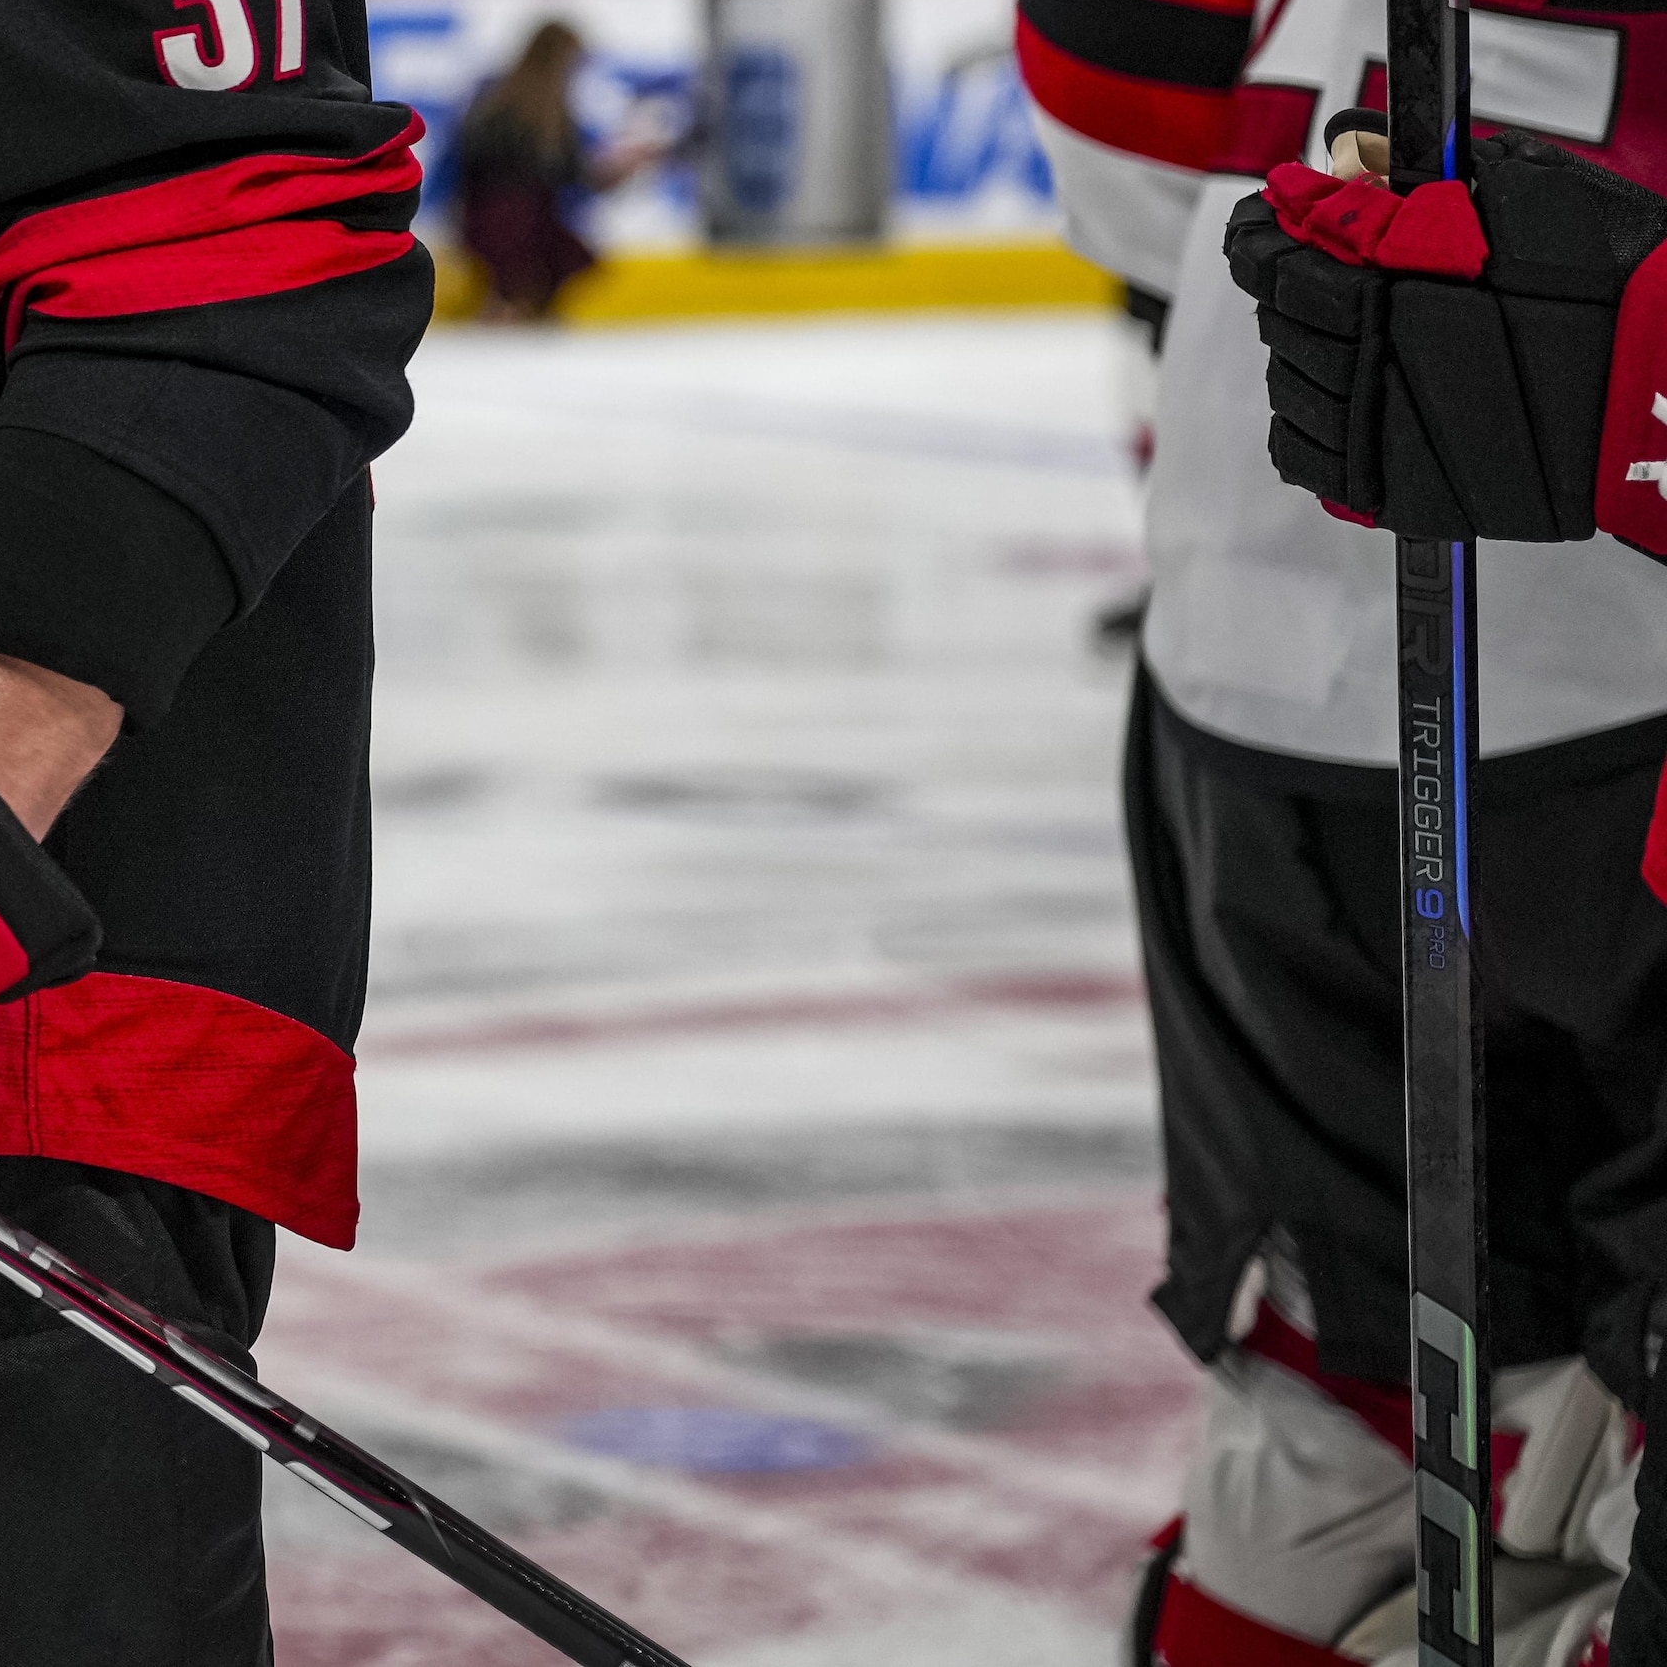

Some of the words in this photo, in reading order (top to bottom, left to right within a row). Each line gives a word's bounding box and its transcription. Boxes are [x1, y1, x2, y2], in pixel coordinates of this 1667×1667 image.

[1413, 697, 1443, 882] TRIGGER
[1415, 887, 1444, 920] 9
[1426, 924, 1445, 970] PRO
